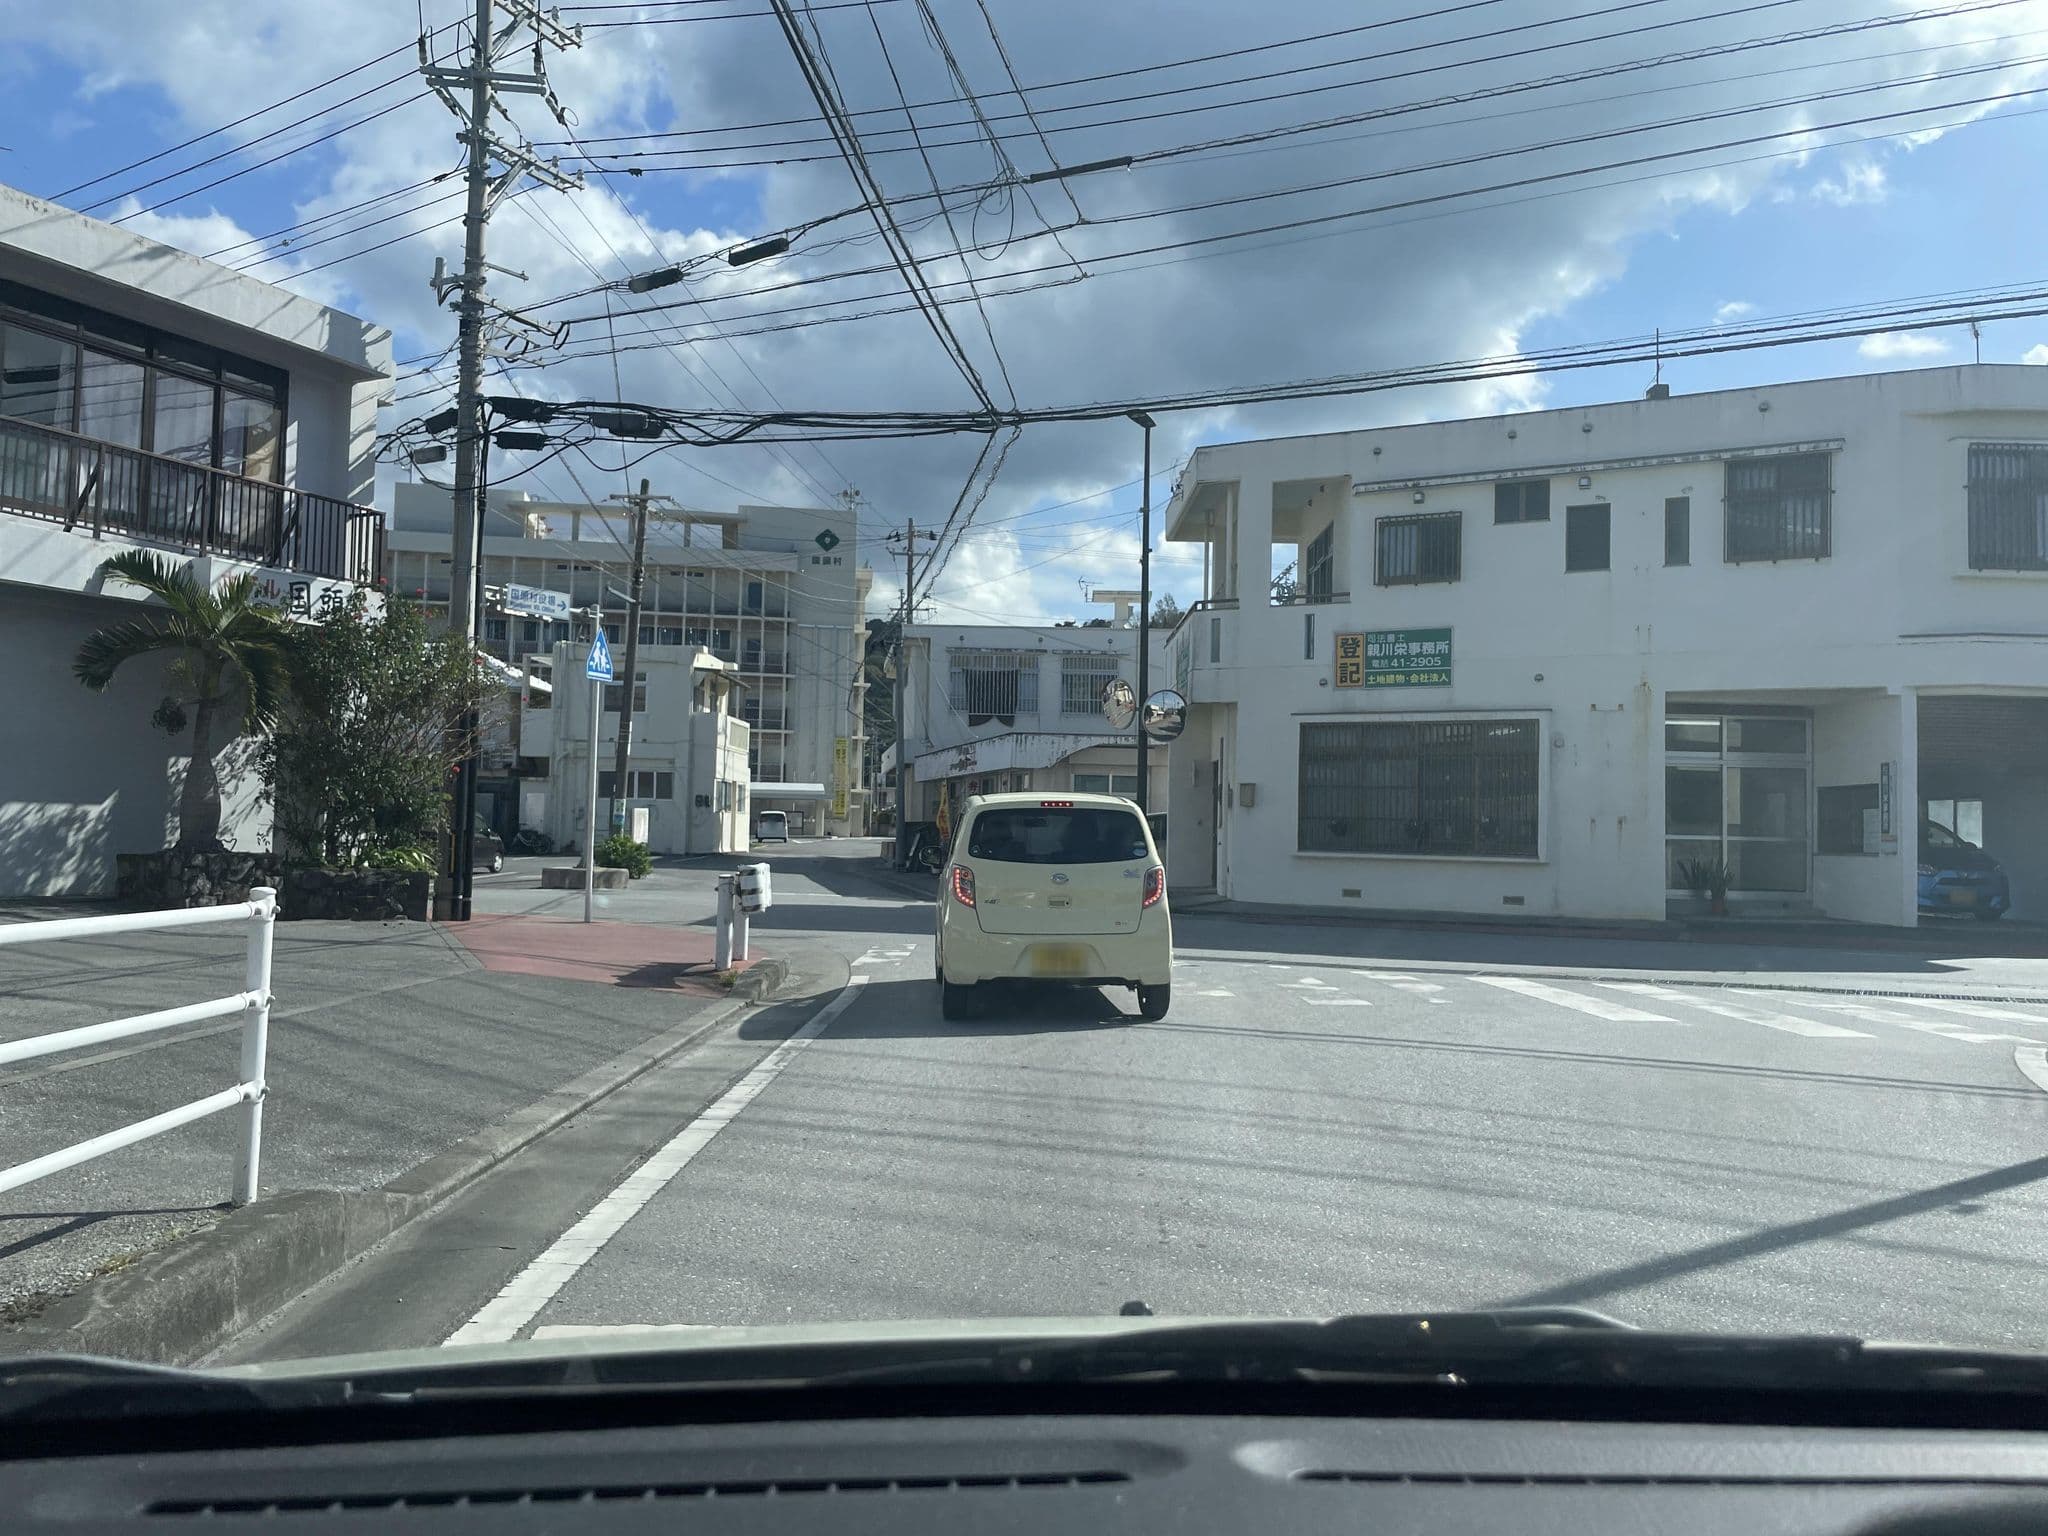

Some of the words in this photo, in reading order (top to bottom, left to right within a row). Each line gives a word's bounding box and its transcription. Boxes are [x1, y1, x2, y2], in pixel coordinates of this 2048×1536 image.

[1367, 633, 1405, 642] 司法書士
[1367, 641, 1449, 656] 親川栄事務所
[1339, 637, 1361, 684] 登記
[1391, 657, 1441, 667] 41-2905
[1367, 674, 1449, 684] 土地建物・会社法人
